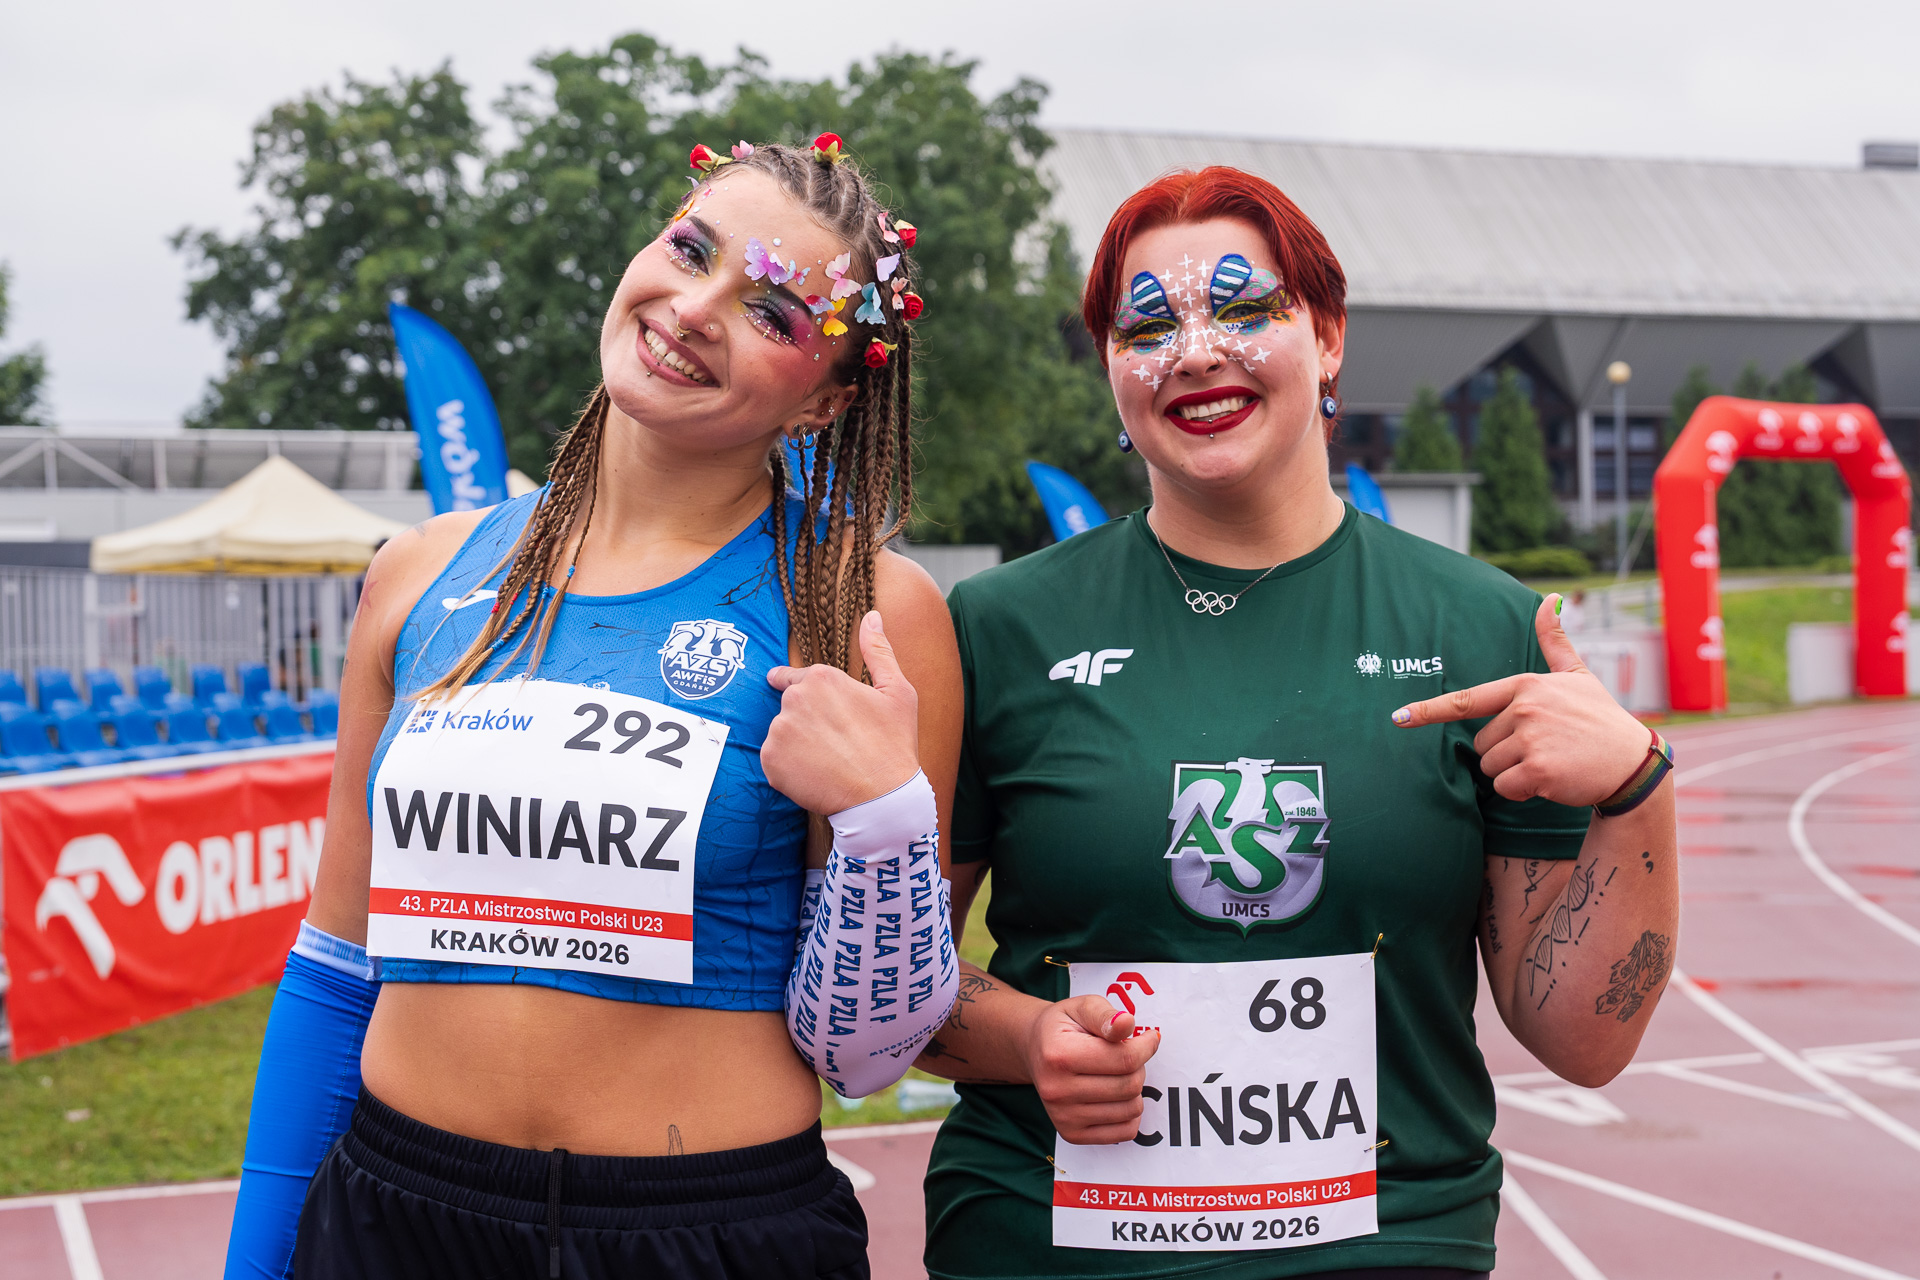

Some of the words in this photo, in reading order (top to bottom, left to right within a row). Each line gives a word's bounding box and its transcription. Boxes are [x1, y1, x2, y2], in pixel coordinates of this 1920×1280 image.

[668, 652, 730, 676] AZS
[673, 680, 710, 692] GDAŃSK
[1391, 656, 1443, 674] UMCS
[441, 708, 533, 731] Kraków
[564, 702, 690, 769] 292
[383, 787, 688, 872] WINIARZ
[1296, 806, 1317, 817] 1946
[155, 815, 328, 935] ORLEN
[877, 856, 901, 903] PZLA
[910, 868, 932, 923] PZLA
[399, 895, 426, 913] 43.
[429, 898, 470, 915] PZLA
[474, 900, 576, 924] Mistrzostwa
[580, 904, 628, 929] Polski
[632, 914, 664, 933] U23
[814, 893, 832, 949] PZLA
[840, 884, 866, 930] PZLA
[1221, 902, 1271, 918] UMCS
[430, 927, 559, 958] KRAKÓW
[565, 937, 630, 965] 2026
[874, 913, 901, 959] PZLA
[910, 925, 933, 977] PZLA
[803, 944, 824, 1003] PZLA
[833, 939, 862, 987] PZLA
[871, 967, 899, 1011] PZLA
[908, 974, 933, 1013] PZL
[1249, 976, 1327, 1032] 68
[794, 994, 817, 1047] PZLA
[827, 993, 858, 1035] PZLA
[1132, 1072, 1367, 1147] CIŃSKA
[1079, 1188, 1104, 1206] 43.
[1108, 1190, 1148, 1207] PZLA
[1152, 1190, 1262, 1208] Mistrzostwa
[1267, 1184, 1317, 1206] Polski
[1321, 1181, 1351, 1200] U23
[1111, 1215, 1245, 1243] KRAKÓW
[1252, 1214, 1320, 1241] 2026
